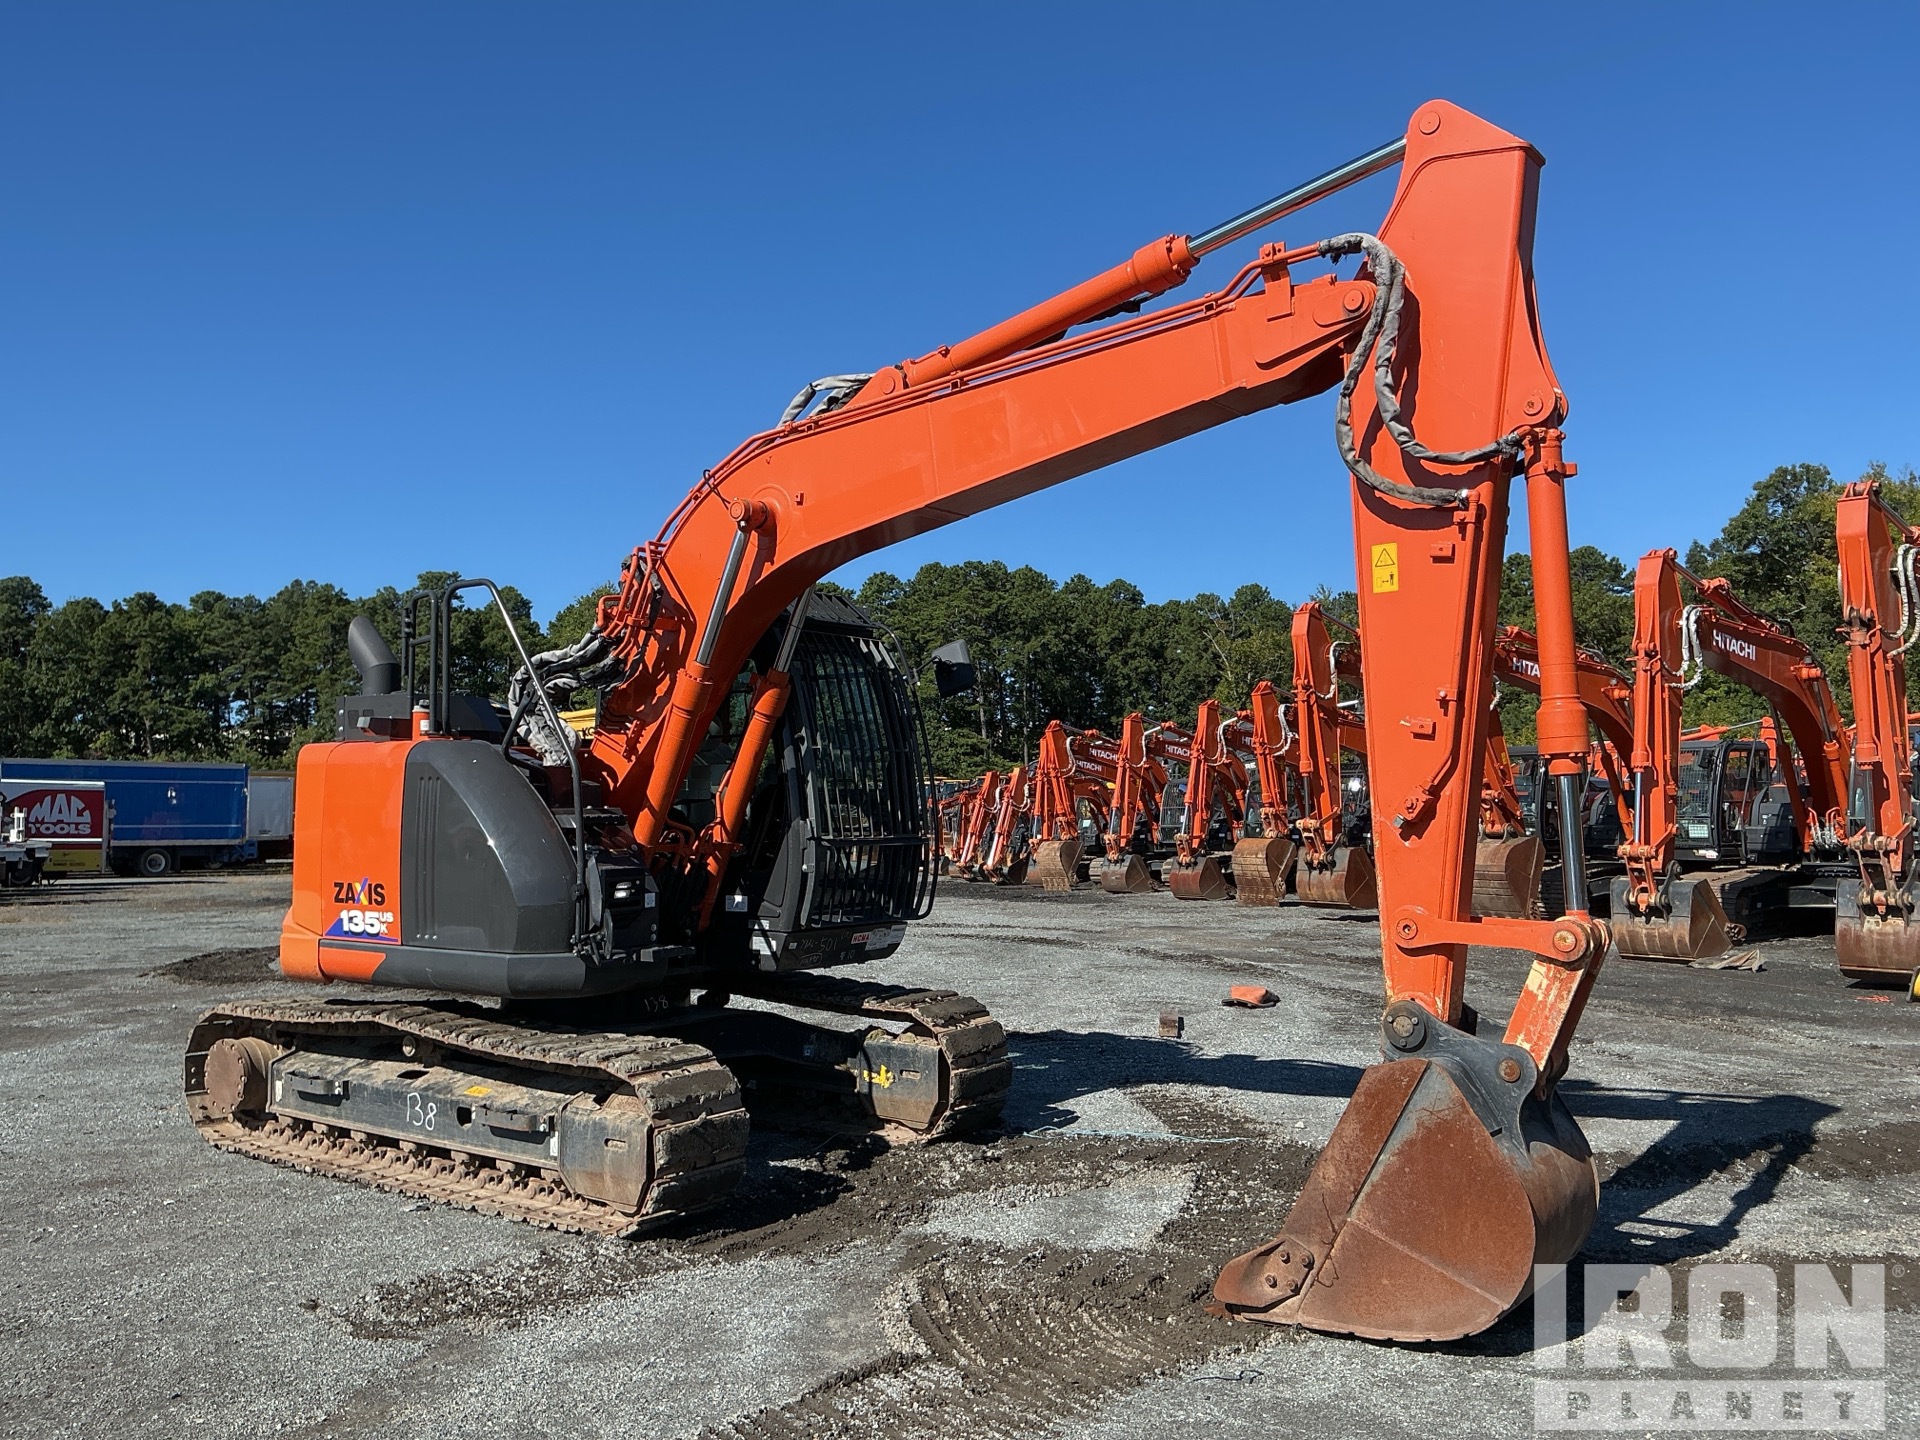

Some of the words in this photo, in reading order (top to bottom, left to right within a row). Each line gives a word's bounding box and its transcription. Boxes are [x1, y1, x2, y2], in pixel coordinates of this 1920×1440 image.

[1712, 629, 1757, 662] HITACHI
[1512, 656, 1541, 679] HITA
[1075, 759, 1102, 772] HITACHI
[28, 793, 91, 823] MAC
[28, 823, 91, 835] TOOLS
[333, 877, 386, 906] ZAXIS
[339, 909, 380, 936] 135
[379, 911, 394, 923] US
[380, 923, 388, 934] K
